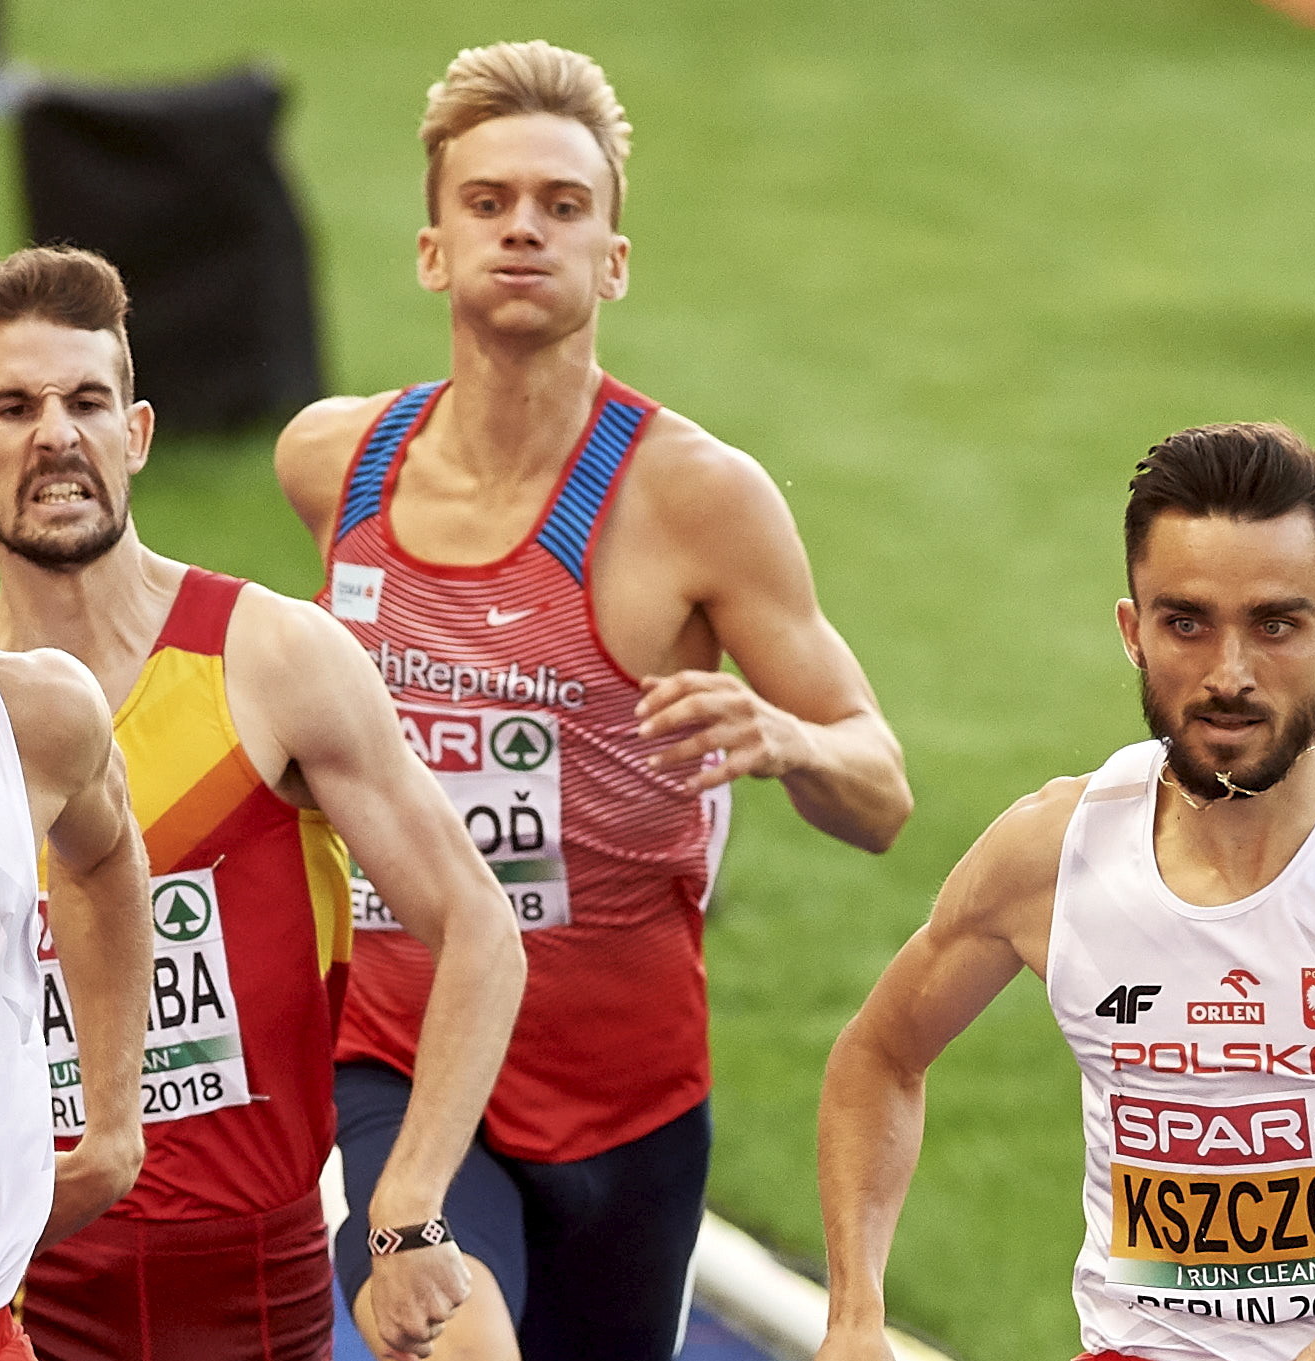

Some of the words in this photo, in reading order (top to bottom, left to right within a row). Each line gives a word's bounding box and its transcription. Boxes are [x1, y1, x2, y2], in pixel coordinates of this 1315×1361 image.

[370, 640, 585, 709] hRepublic
[401, 717, 478, 764] AR
[1191, 1005, 1261, 1022] ORLEN
[141, 1072, 224, 1114] 2018
[1116, 1105, 1305, 1157] SPAR
[1176, 1266, 1184, 1285] I
[1190, 1263, 1240, 1287] RUN
